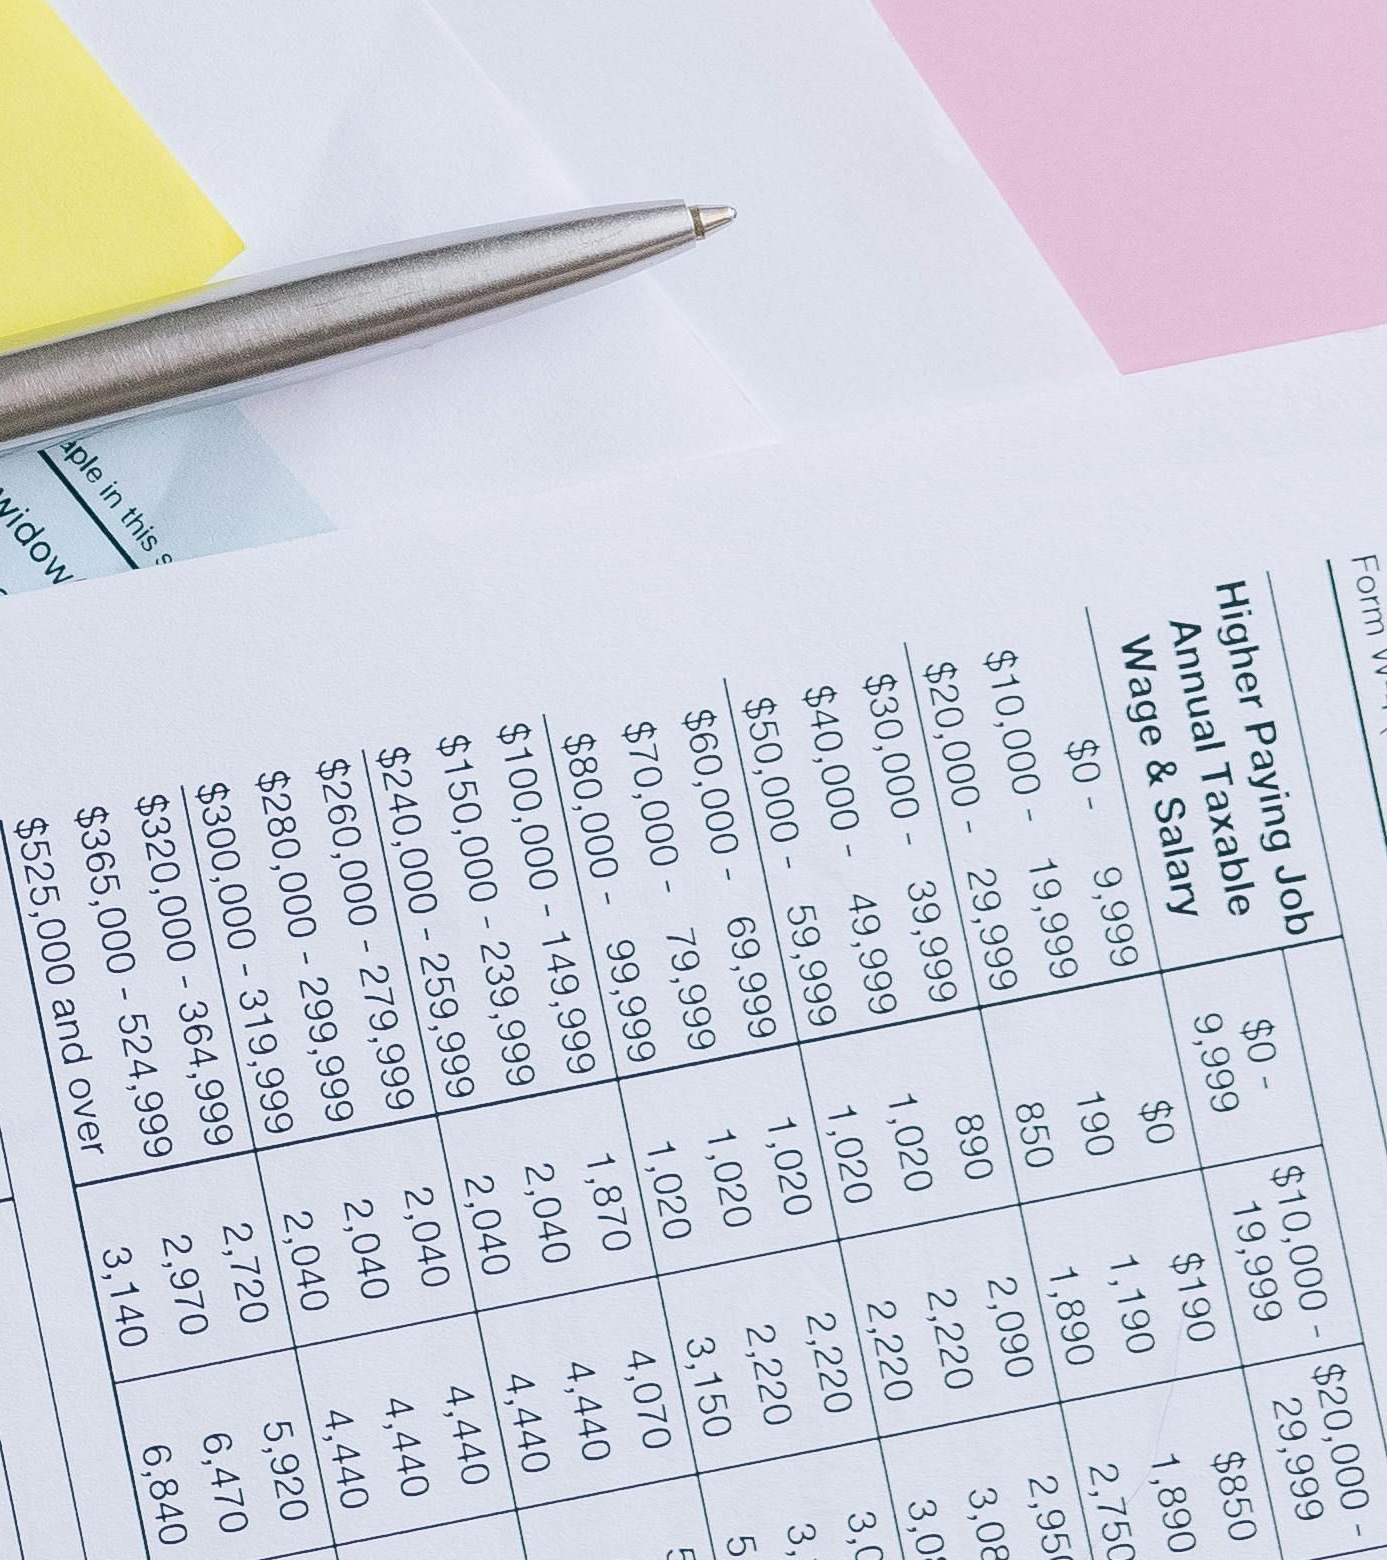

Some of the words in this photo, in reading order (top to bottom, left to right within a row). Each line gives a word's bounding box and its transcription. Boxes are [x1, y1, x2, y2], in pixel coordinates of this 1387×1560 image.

[1120, 633, 1163, 747] Wage
[1145, 759, 1179, 788] &
[1168, 619, 1227, 753] Annual
[1199, 760, 1256, 917] Taxable
[1214, 579, 1264, 709] Higher
[1243, 719, 1292, 853] Paying
[1274, 864, 1315, 936] Job
[1153, 796, 1199, 917] Salary
[1076, 1090, 1116, 1157] 190
